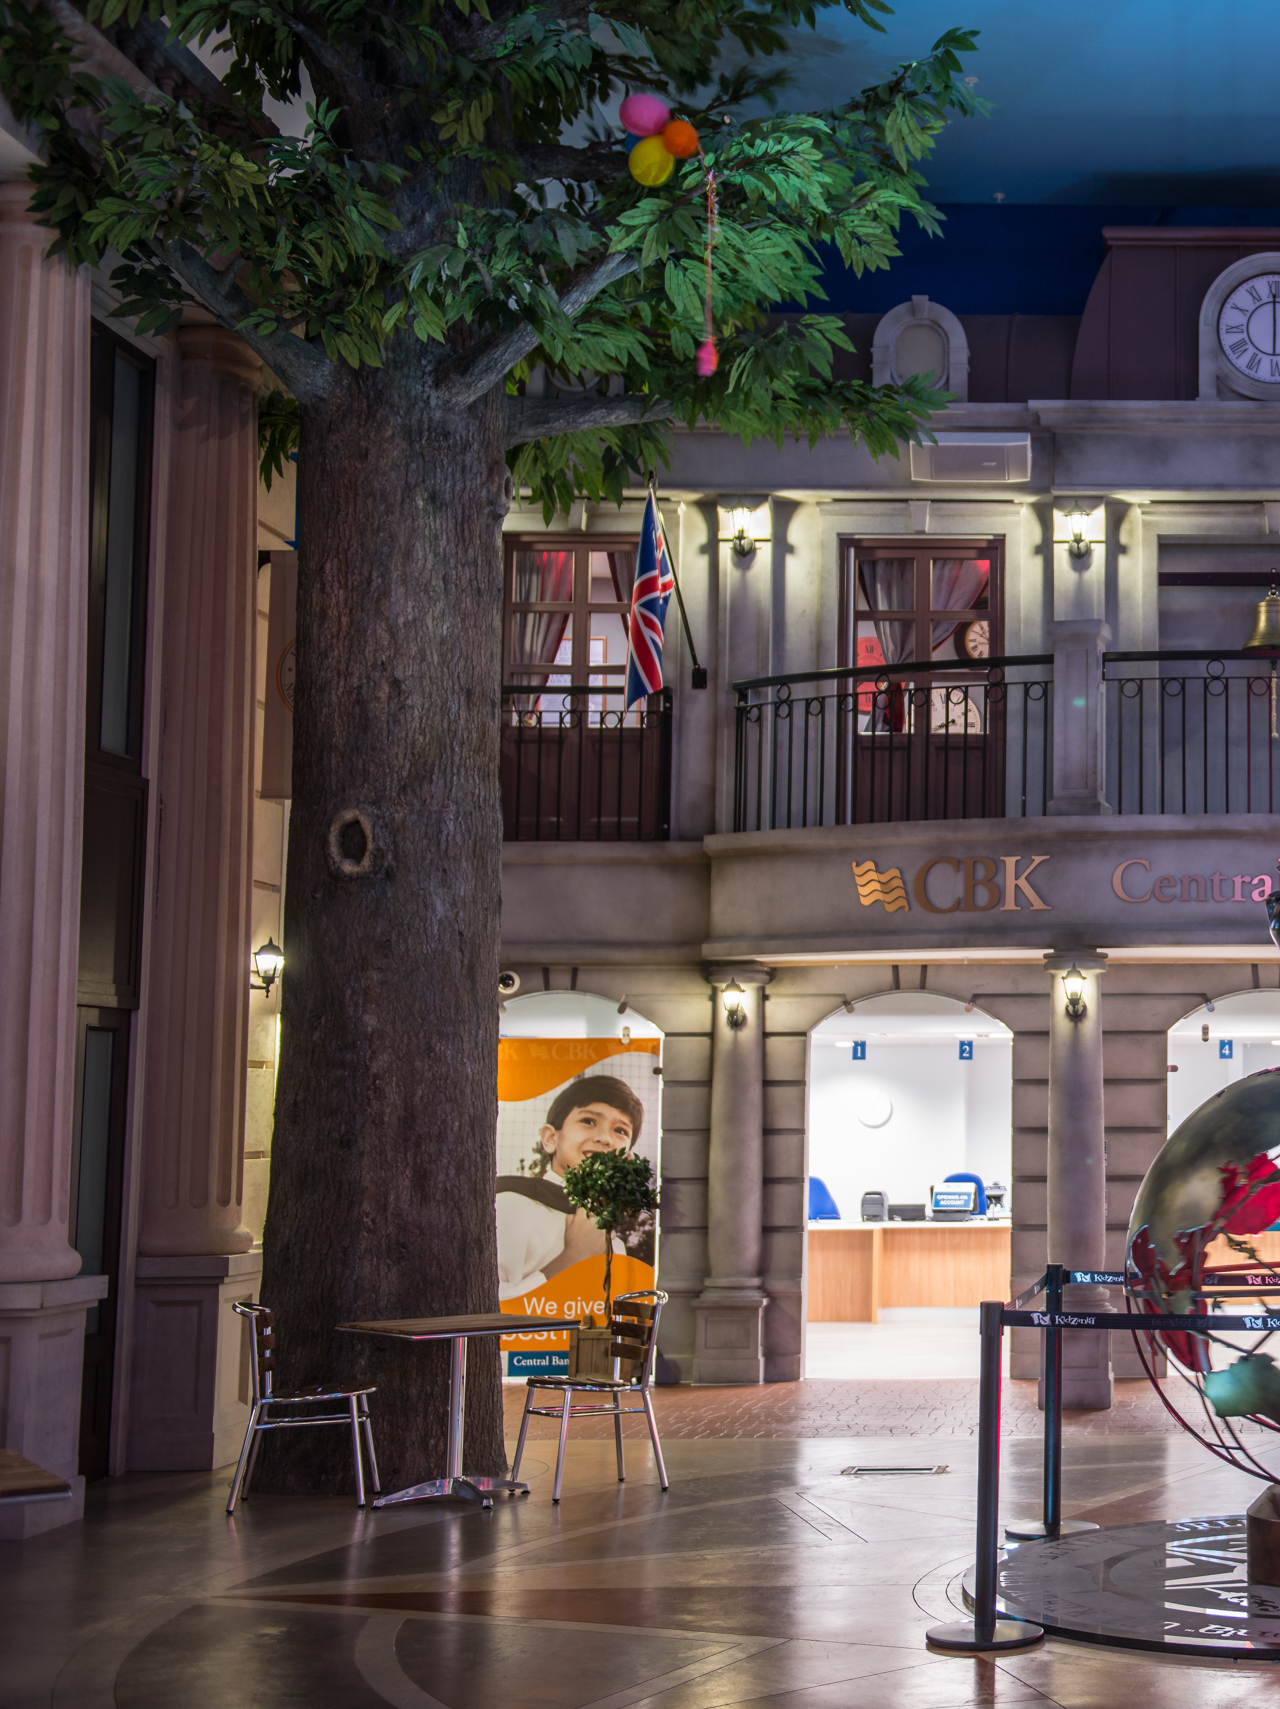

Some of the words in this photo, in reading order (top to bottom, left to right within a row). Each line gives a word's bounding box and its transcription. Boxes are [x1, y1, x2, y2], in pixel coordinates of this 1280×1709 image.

[1245, 285, 1263, 304] XI
[1267, 281, 1280, 298] XII
[1230, 302, 1249, 316] X
[1225, 324, 1244, 334] IX
[1270, 358, 1280, 376] VI
[913, 855, 1052, 914] CBK
[551, 1042, 599, 1060] CBK
[856, 1046, 862, 1057] 1
[962, 1045, 970, 1057] 2
[1221, 1045, 1230, 1056] 4
[523, 1296, 558, 1315] We
[563, 1296, 606, 1319] give
[1055, 1314, 1096, 1325] KidZania
[513, 1356, 549, 1366] Central
[551, 1356, 569, 1366] Ban
